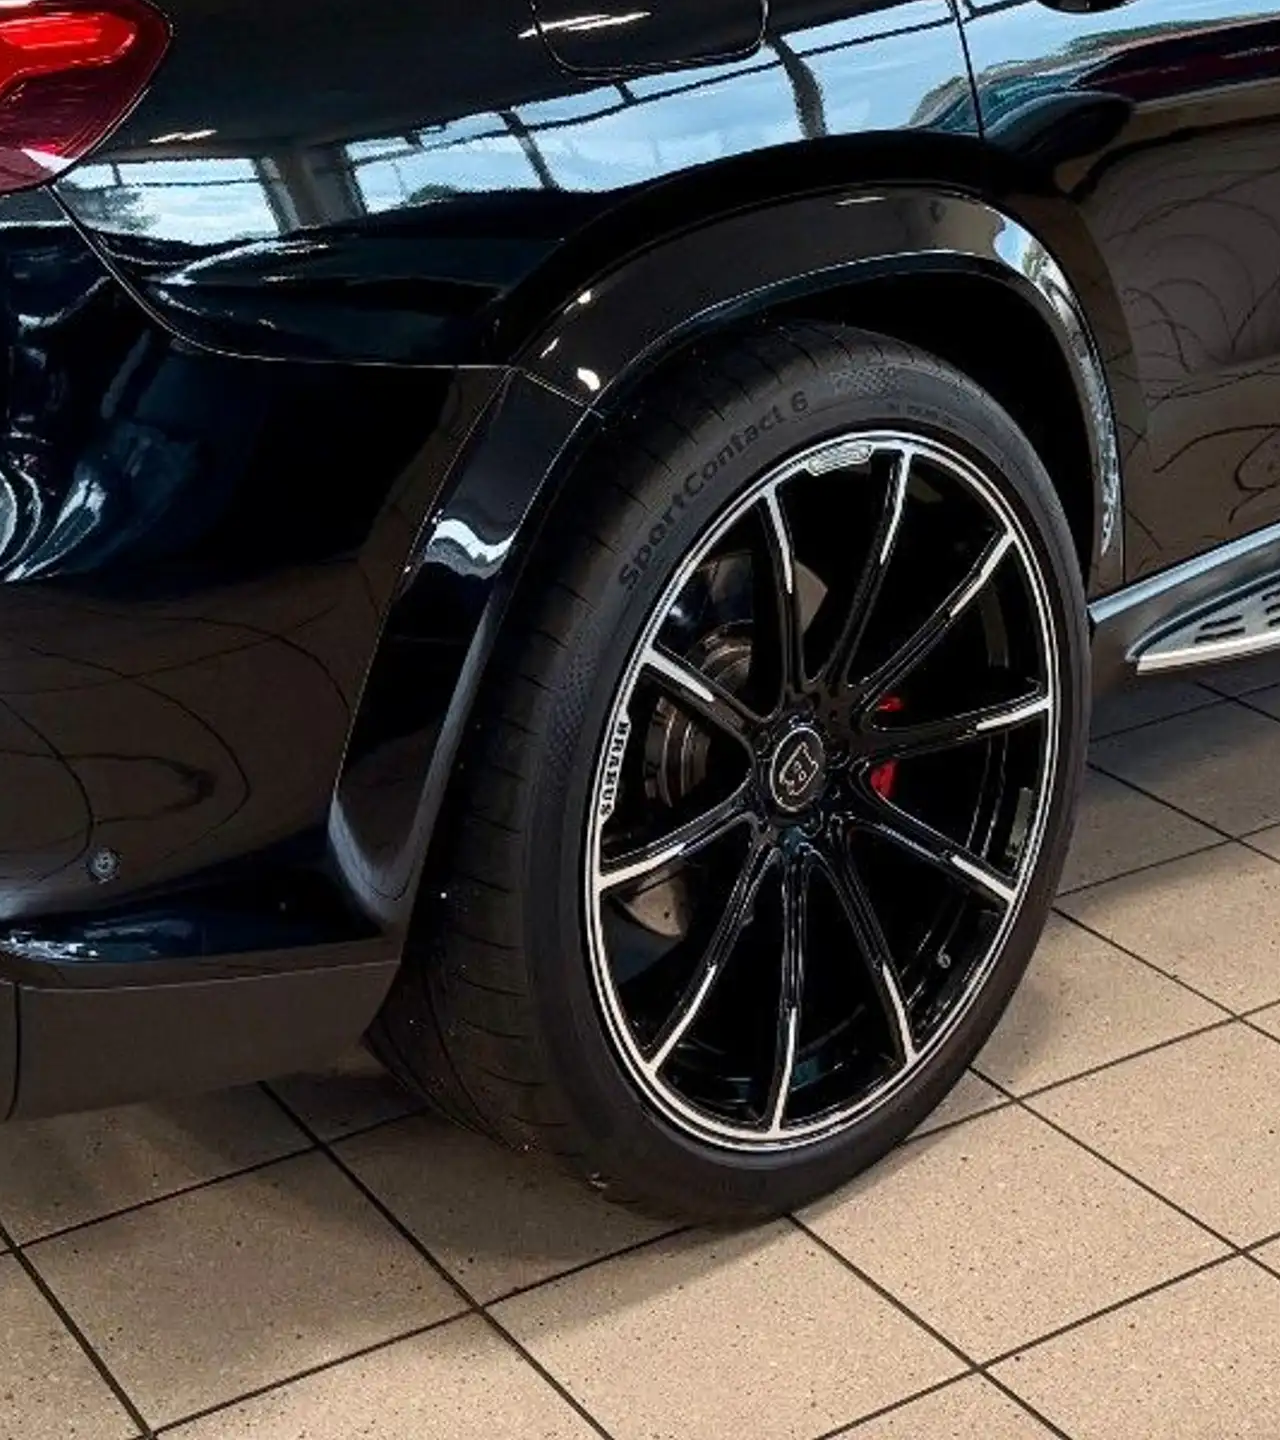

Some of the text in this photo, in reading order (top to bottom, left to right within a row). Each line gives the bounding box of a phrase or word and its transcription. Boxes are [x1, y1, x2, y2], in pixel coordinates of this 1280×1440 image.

[618, 389, 810, 591] SportContact 6
[599, 720, 631, 818] BRABUS
